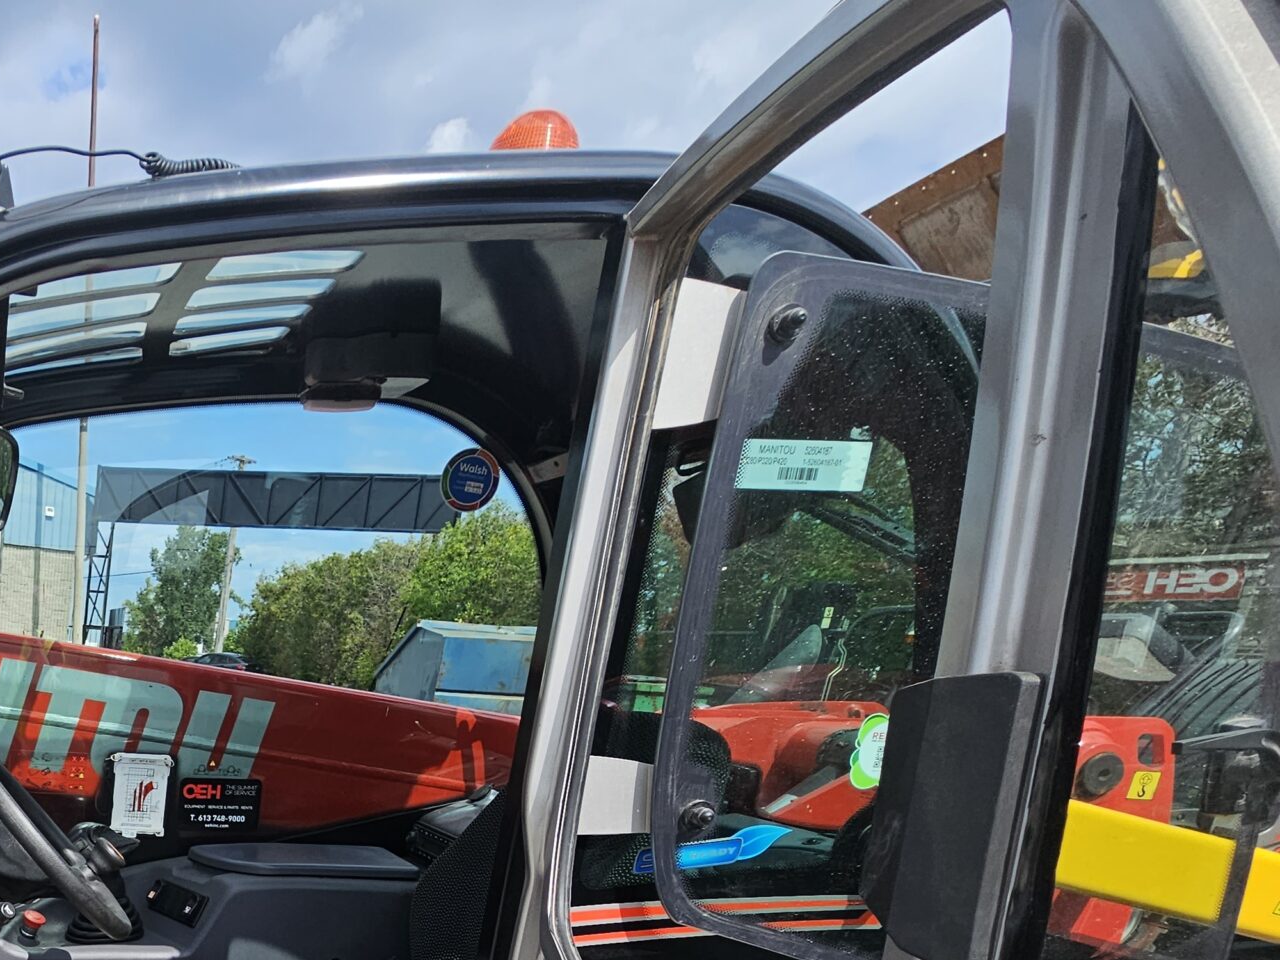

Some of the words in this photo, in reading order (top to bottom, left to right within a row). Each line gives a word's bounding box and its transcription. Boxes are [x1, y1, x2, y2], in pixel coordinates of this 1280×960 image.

[759, 445, 796, 455] MANITOU
[460, 462, 488, 475] Walsh
[183, 784, 222, 800] OEH
[212, 815, 246, 823] 748-9000
